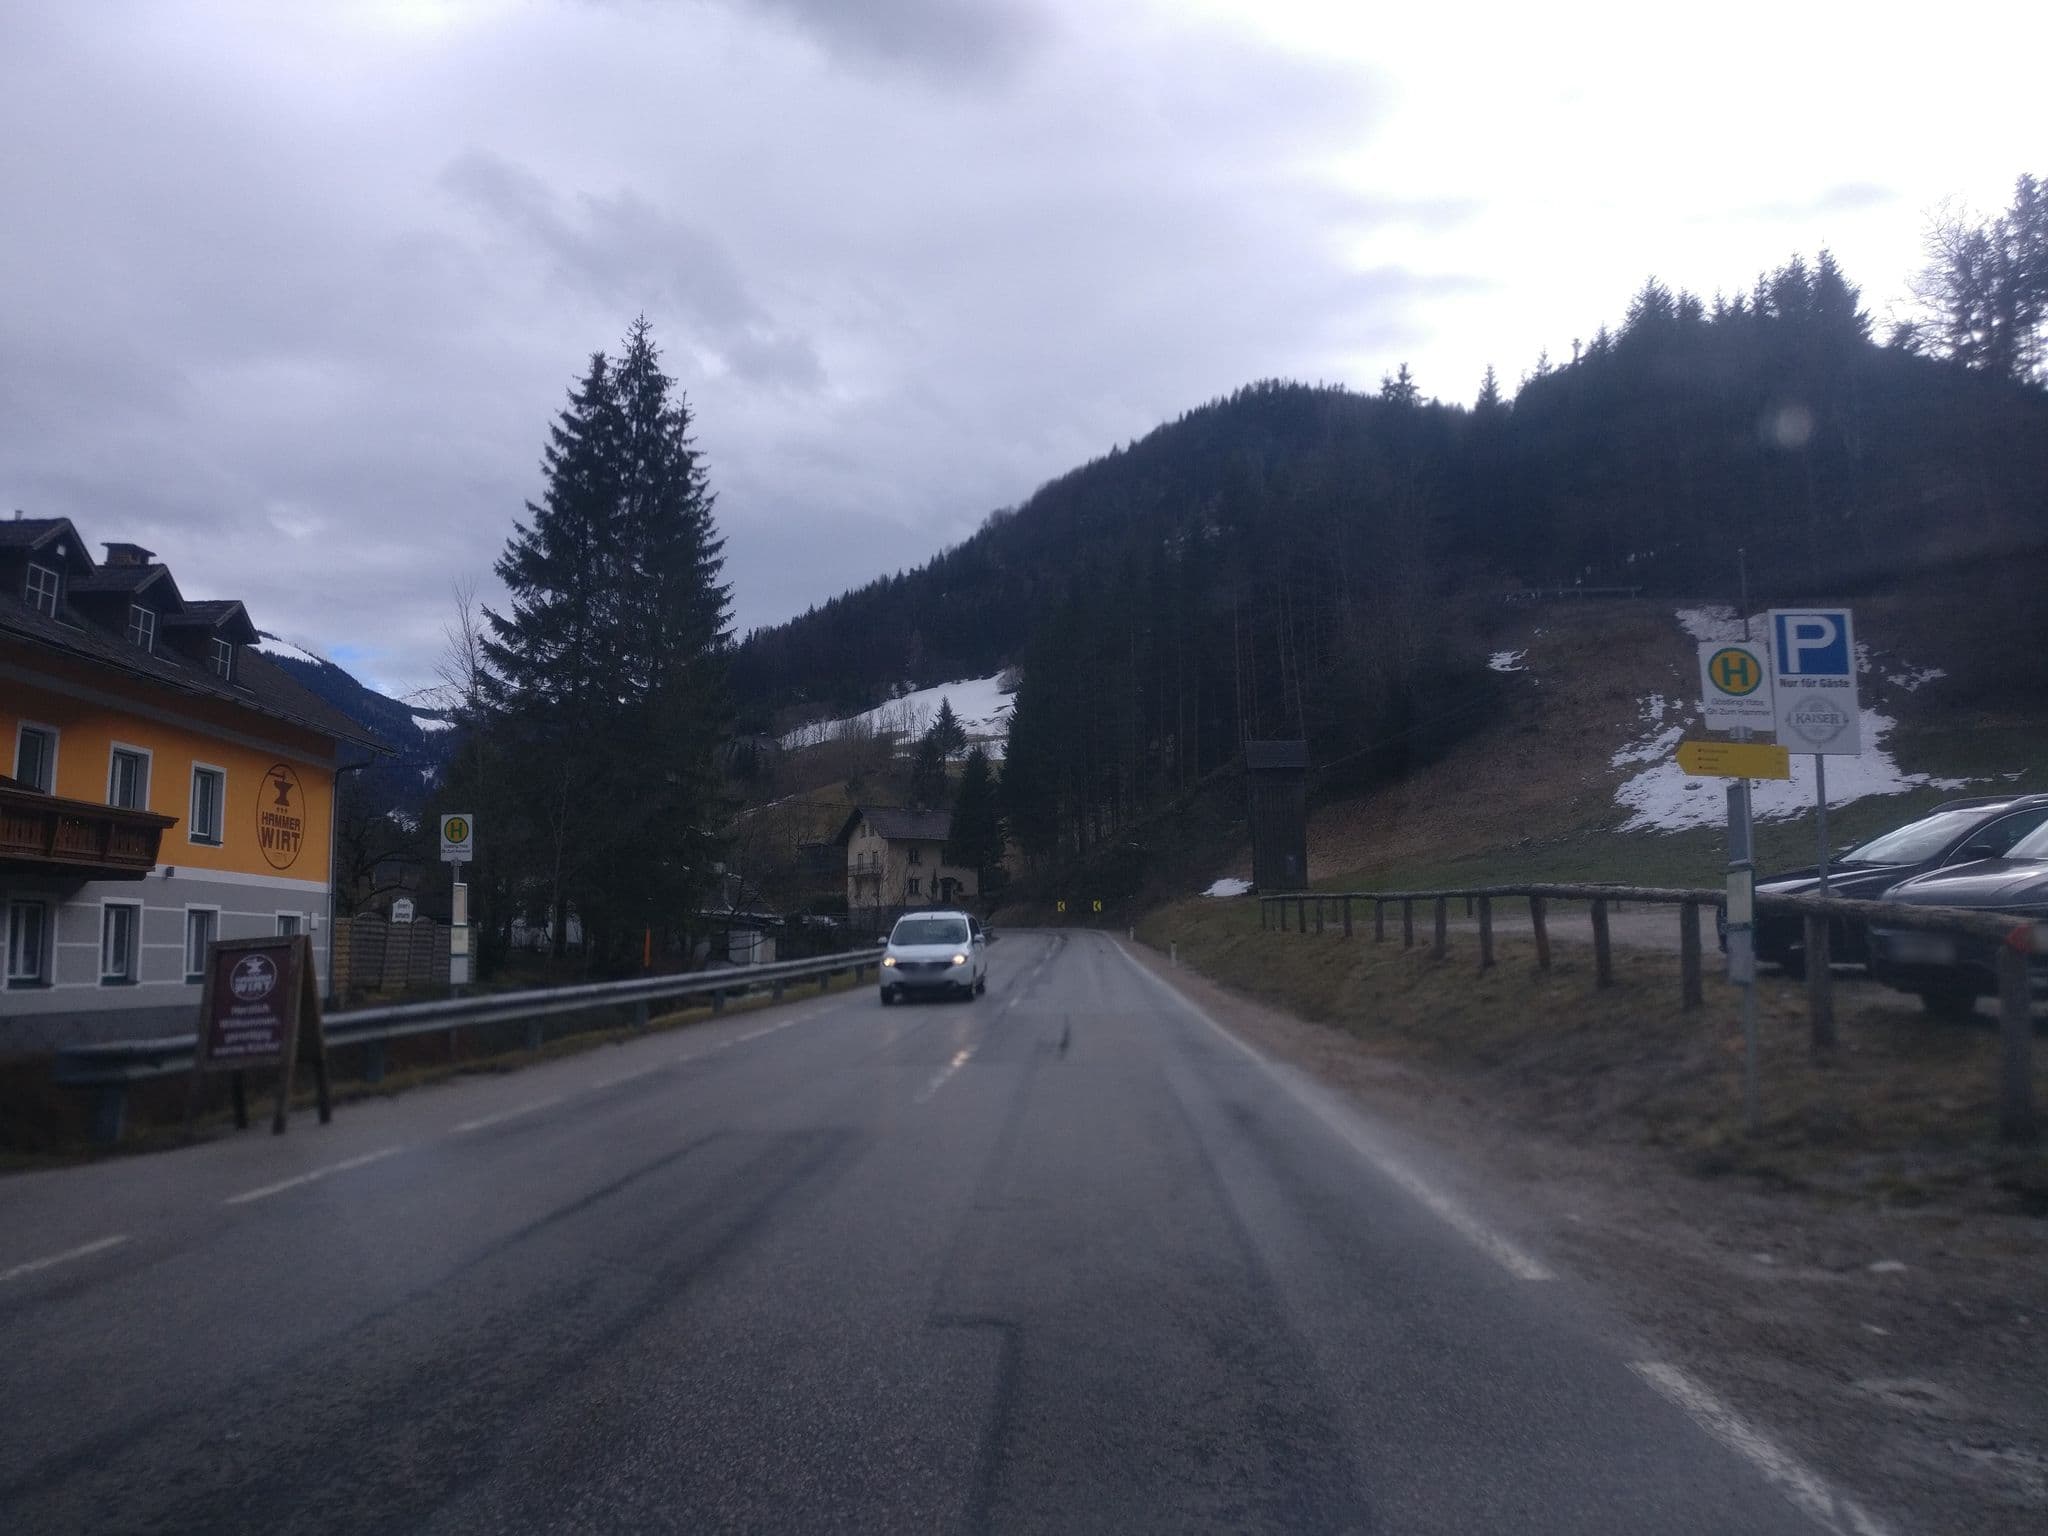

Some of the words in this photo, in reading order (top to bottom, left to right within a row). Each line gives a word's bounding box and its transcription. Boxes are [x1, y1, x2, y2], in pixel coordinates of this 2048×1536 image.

[1784, 615, 1836, 673] P
[1721, 657, 1749, 686] H
[1779, 678, 1798, 688] Nur
[1800, 678, 1817, 688] für
[1819, 678, 1850, 688] Gäste
[1795, 713, 1839, 725] KAISER
[261, 811, 301, 831] HAMMER
[450, 822, 462, 838] H
[261, 826, 300, 853] WIRT
